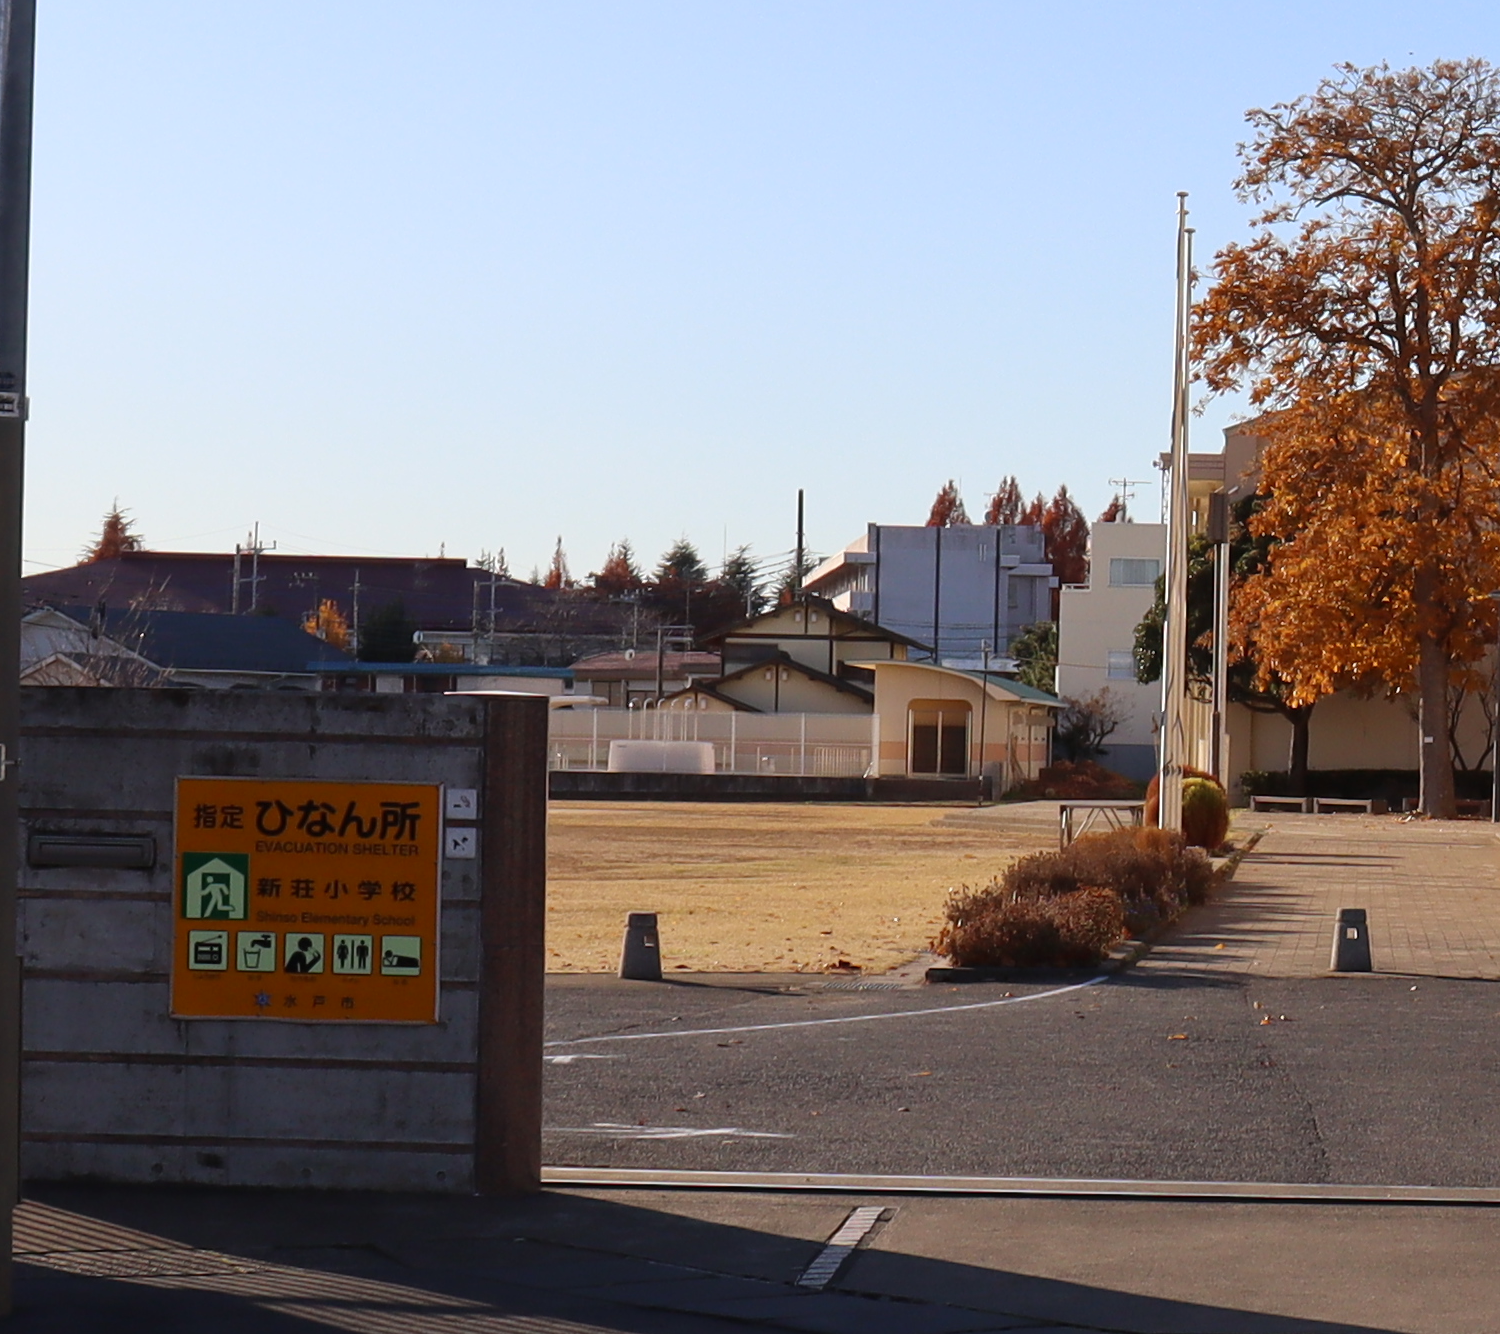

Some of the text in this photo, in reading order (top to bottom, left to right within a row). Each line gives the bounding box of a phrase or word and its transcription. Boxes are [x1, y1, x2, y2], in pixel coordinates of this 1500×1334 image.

[194, 800, 420, 840] 指定 ひなん所
[255, 842, 419, 857] EVACUATION SHELTER
[257, 878, 416, 902] 新荘小学校
[257, 910, 415, 927] Shinso Elementary School
[283, 995, 355, 1010] 水戸市
